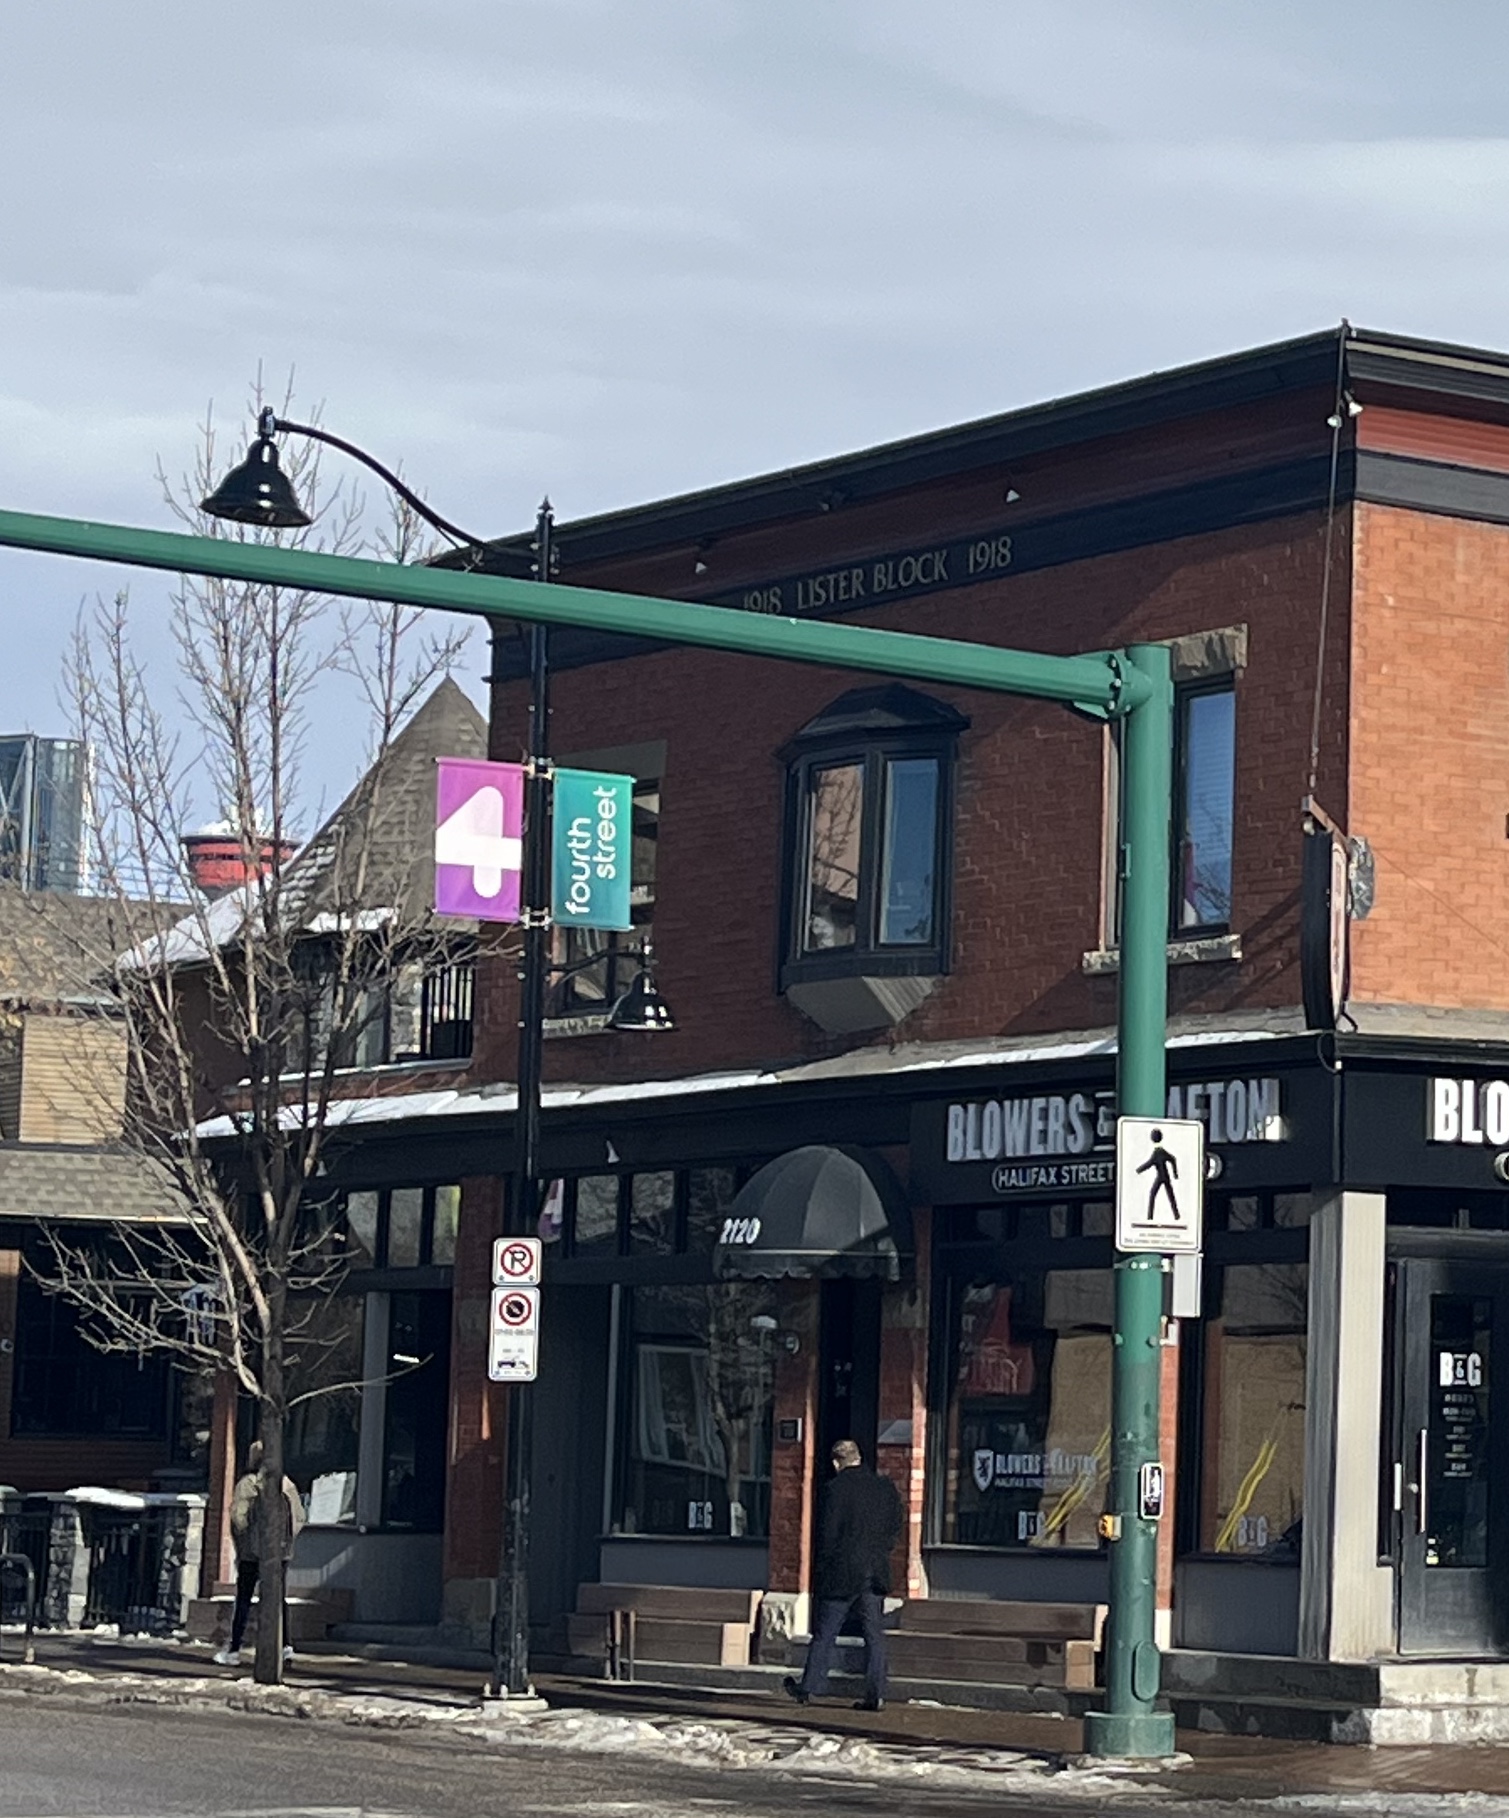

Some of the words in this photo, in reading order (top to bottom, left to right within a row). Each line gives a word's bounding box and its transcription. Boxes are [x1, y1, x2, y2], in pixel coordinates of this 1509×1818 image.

[797, 568, 865, 610] LISTER
[873, 550, 949, 594] BLOCK
[969, 536, 1012, 573] 1918
[565, 817, 592, 914] fourth
[593, 785, 617, 880] street
[947, 1093, 1090, 1161] BLOWERS
[1167, 1079, 1273, 1143] AFTON
[998, 1167, 1058, 1187] HALIFAX
[1061, 1162, 1115, 1185] STREET
[719, 1217, 761, 1244] 2120
